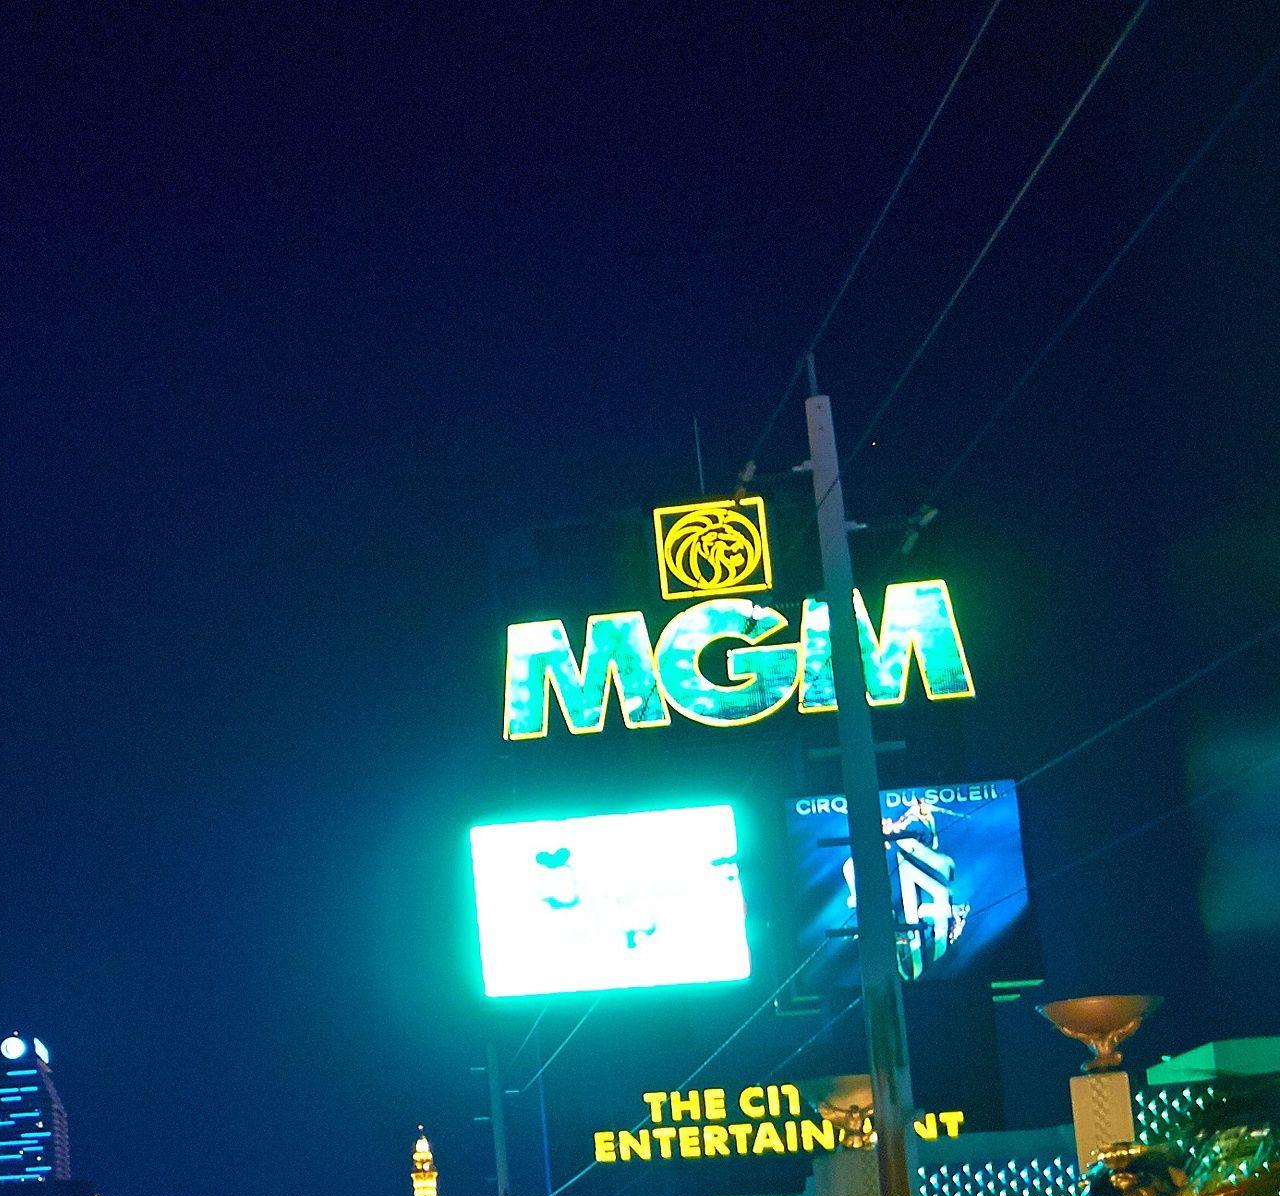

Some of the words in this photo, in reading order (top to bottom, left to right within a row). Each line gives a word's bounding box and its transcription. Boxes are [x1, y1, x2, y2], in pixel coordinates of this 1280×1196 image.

[503, 579, 976, 740] MGM
[886, 790, 917, 808] DU
[642, 1088, 727, 1123] THE
[738, 1084, 801, 1117] CIT
